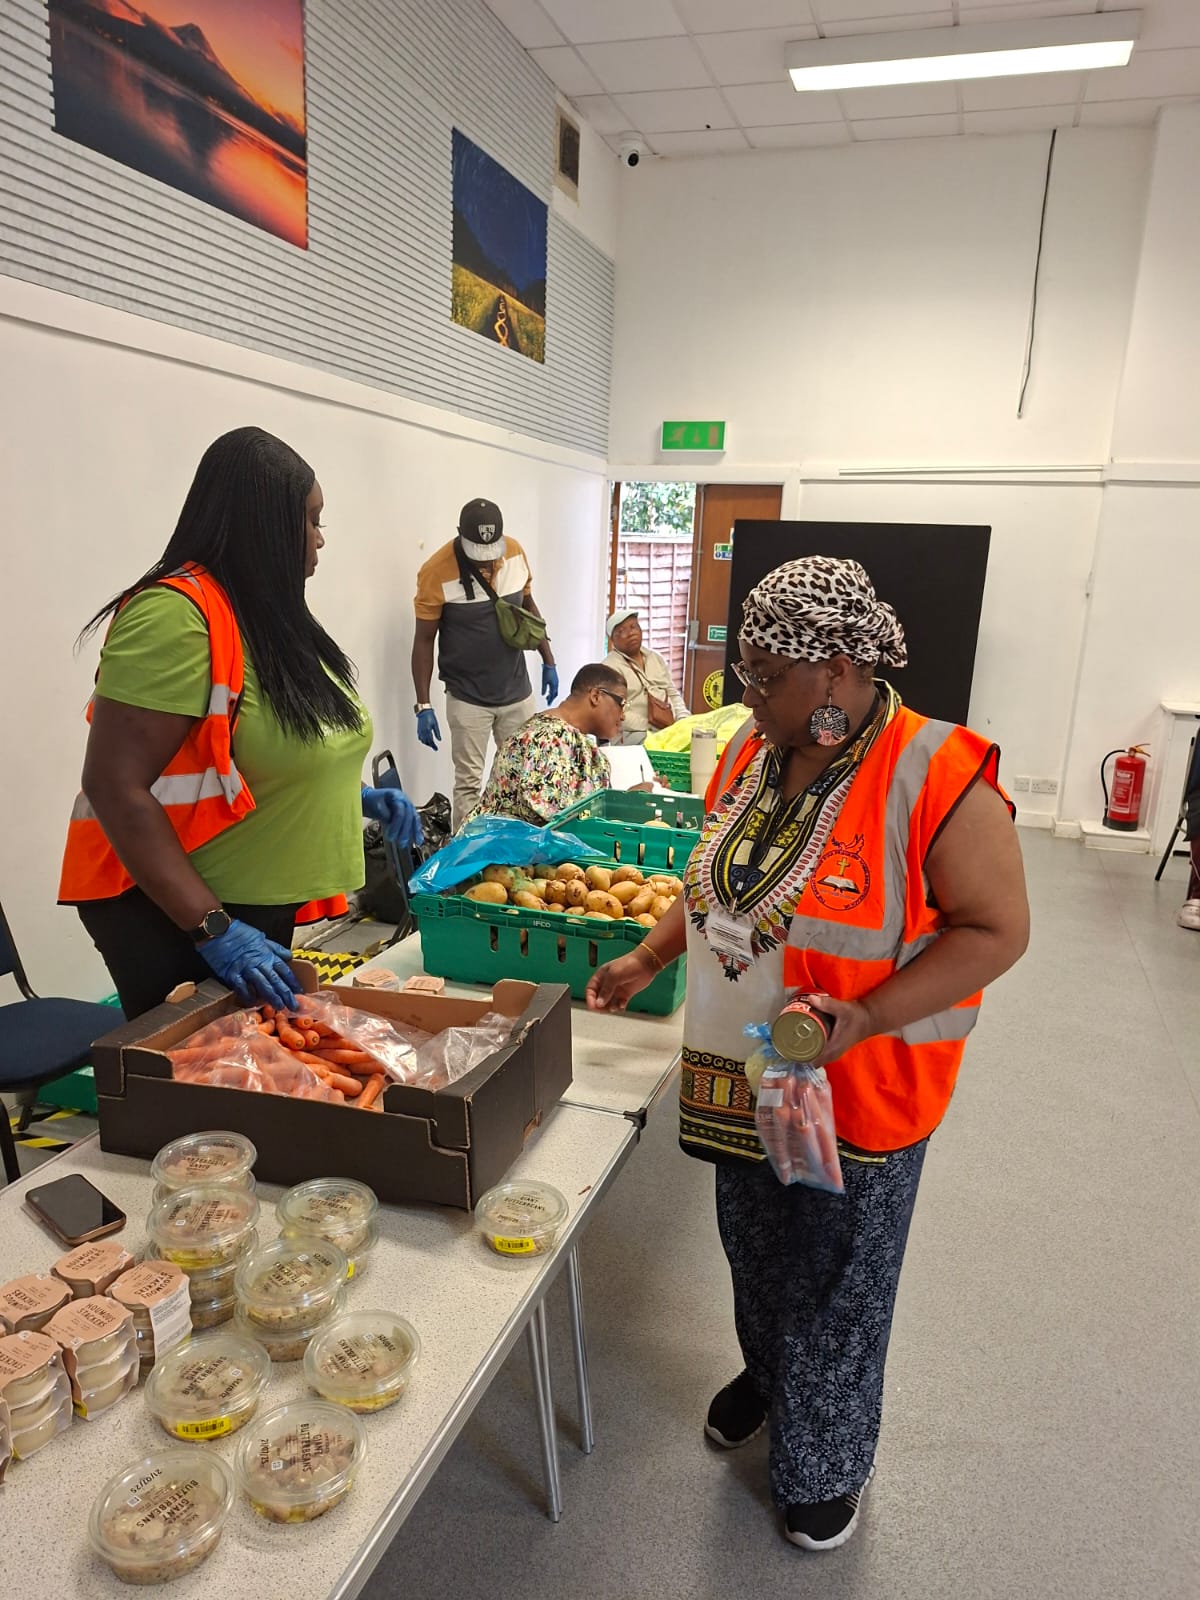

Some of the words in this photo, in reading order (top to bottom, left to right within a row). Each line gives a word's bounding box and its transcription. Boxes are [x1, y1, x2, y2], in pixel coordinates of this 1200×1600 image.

[533, 919, 551, 928] IFCO
[133, 1271, 169, 1296] STACKERS
[140, 1274, 175, 1299] HOUMOUS
[77, 1307, 108, 1328] STACKERS
[86, 1303, 117, 1324] HOUMOUS
[181, 1356, 227, 1395] BUTTERBEANS
[300, 1423, 313, 1473] BUTTERBEANS
[313, 1434, 323, 1456] GIANT
[130, 1468, 163, 1494] 21/07/25
[136, 1479, 199, 1528] BUTTERBEANS
[162, 1499, 190, 1522] GIANT
